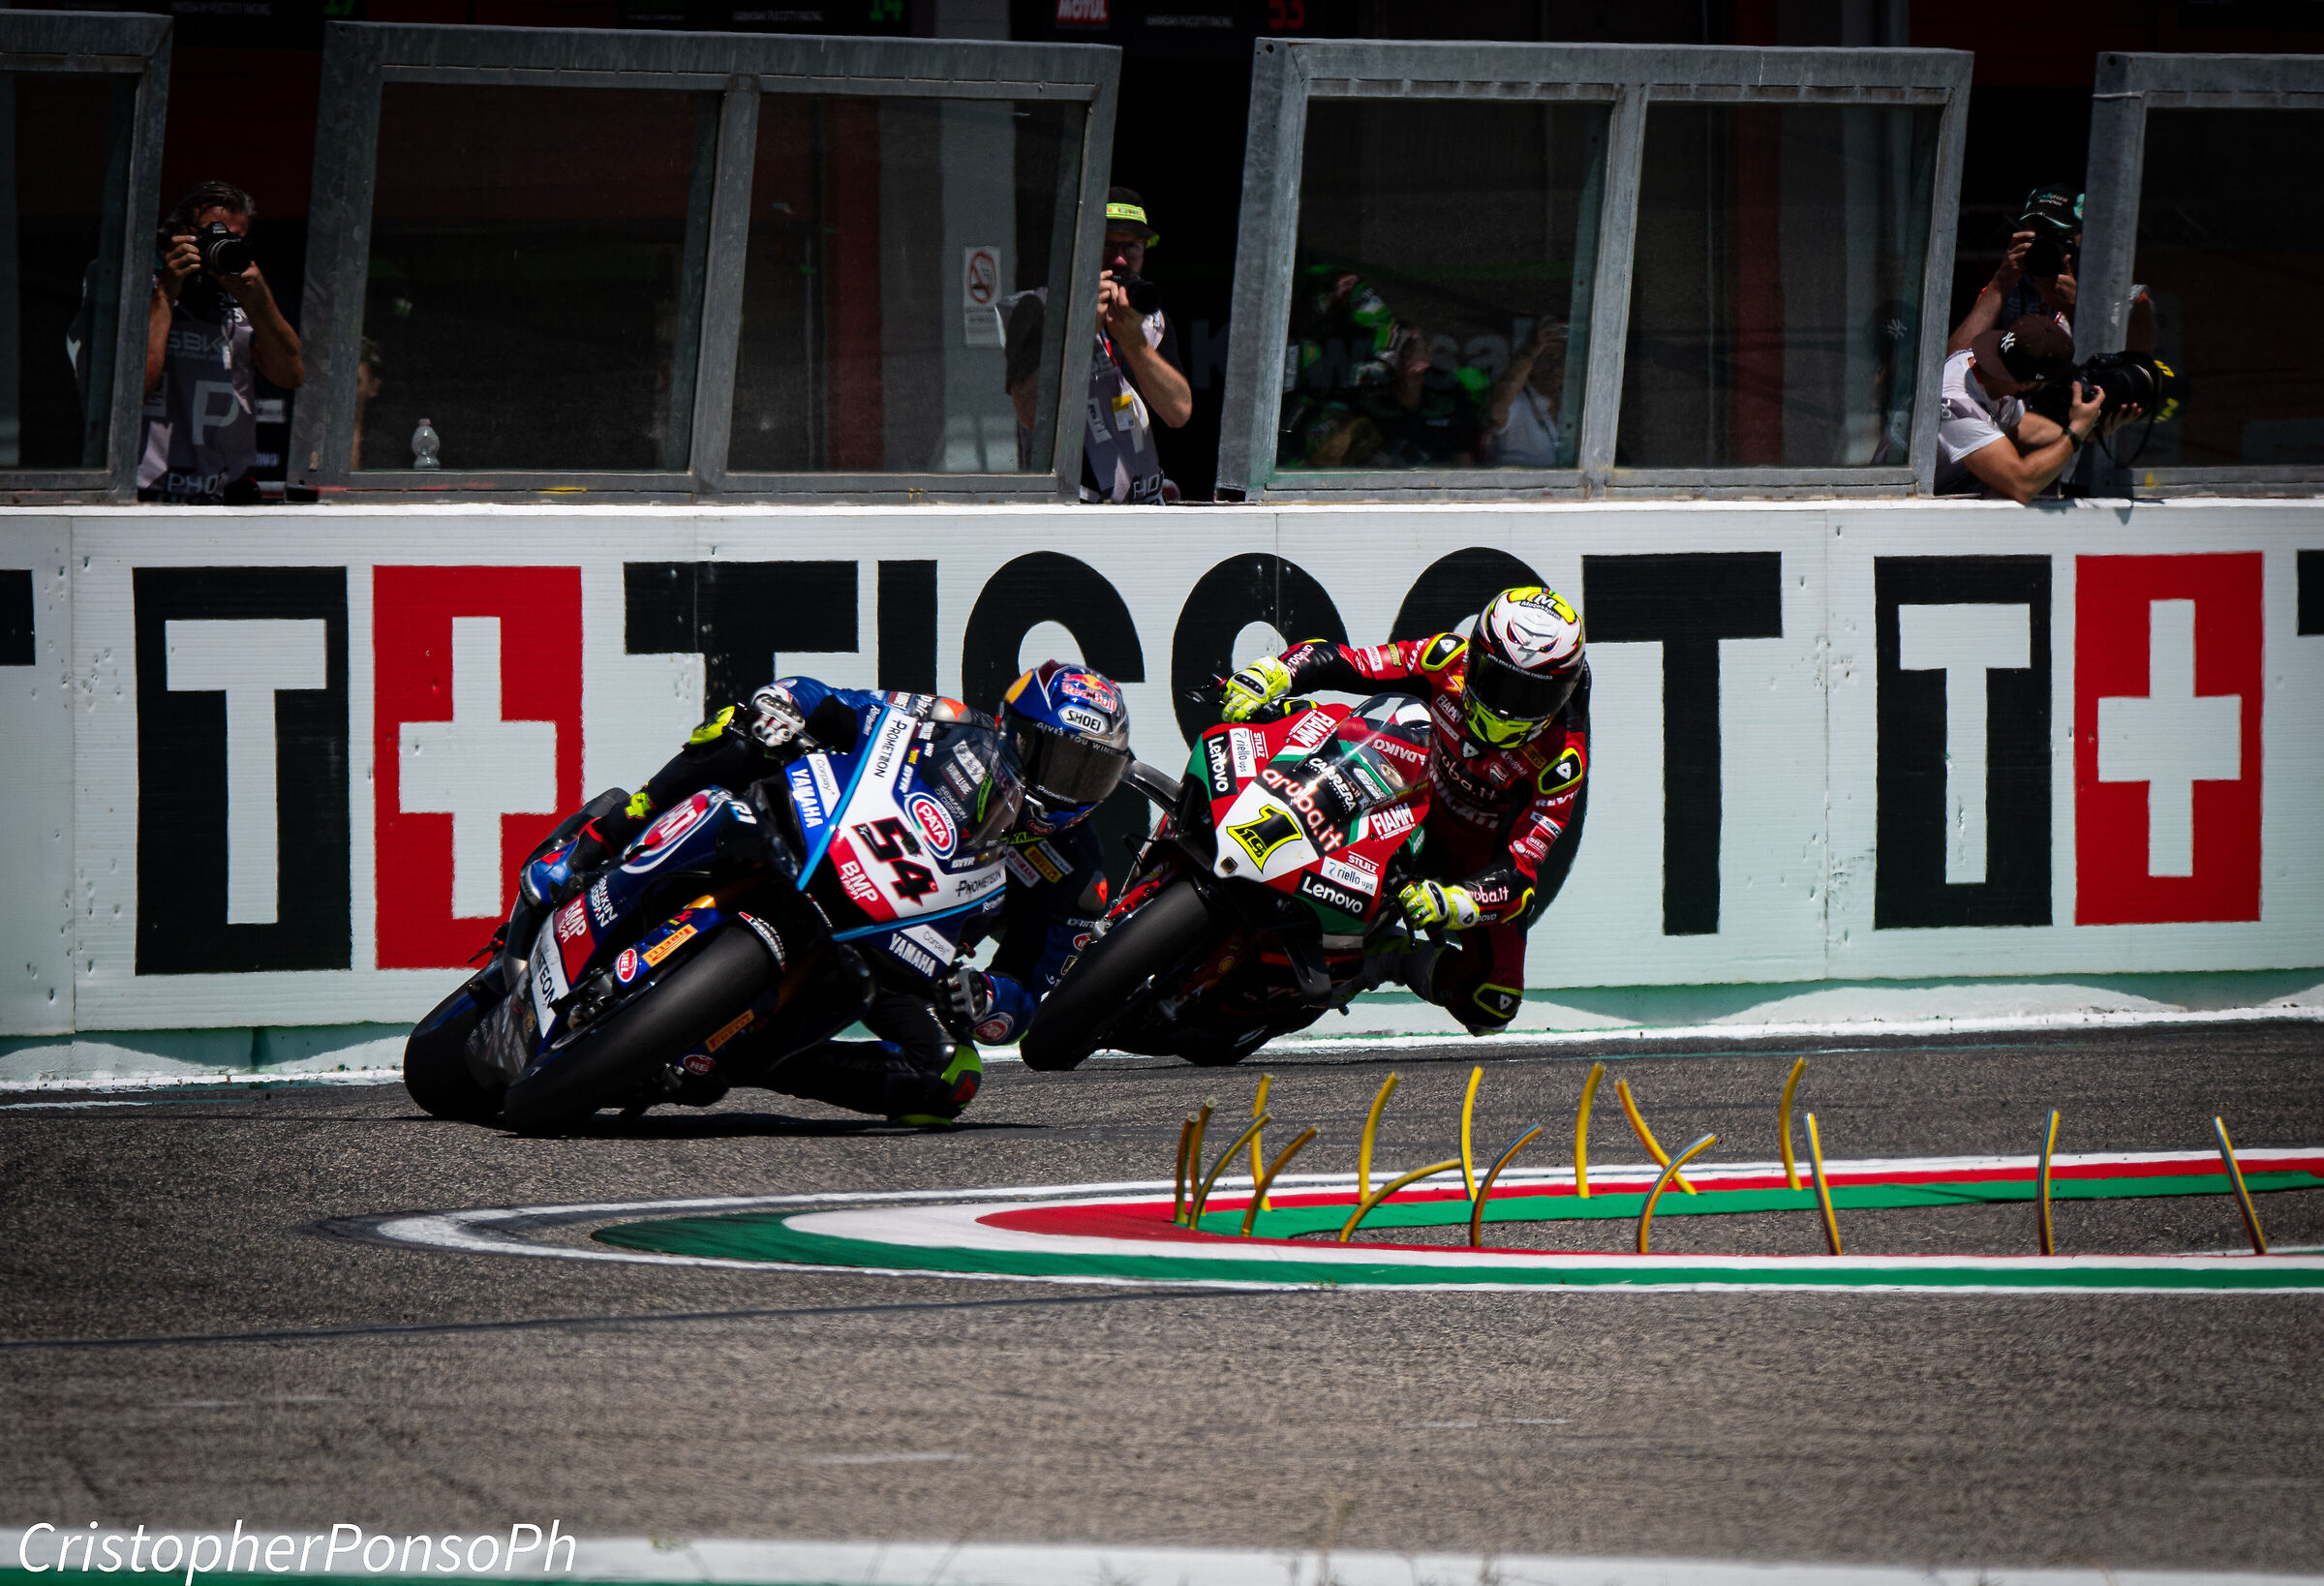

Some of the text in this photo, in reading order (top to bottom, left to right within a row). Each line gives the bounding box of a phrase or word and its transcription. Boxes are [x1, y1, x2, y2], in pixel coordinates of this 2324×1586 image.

[1057, 0, 1107, 18] MOTUL
[1061, 682, 1117, 712] Red Bull
[1436, 693, 1463, 723] FIAMM
[1036, 722, 1065, 737] GIVES
[1068, 733, 1088, 746] YOU
[1066, 710, 1102, 732] SHOEI
[1293, 710, 1336, 748] FIAMM
[1208, 735, 1230, 793] Lenovo
[1235, 739, 1252, 761] riello
[790, 768, 825, 829] YAMAHA
[1308, 757, 1358, 812] CARRERA
[917, 804, 949, 845] PATA
[1261, 767, 1346, 853] aruba.it
[1370, 802, 1415, 838] FIAMM
[851, 816, 939, 906] 54
[1336, 867, 1374, 891] riello ups
[1347, 853, 1379, 874] STULZ
[840, 860, 880, 902] BMP
[1301, 875, 1363, 915] Lenovo
[647, 927, 693, 961] PIRELLI
[888, 932, 937, 978] YAMAHA
